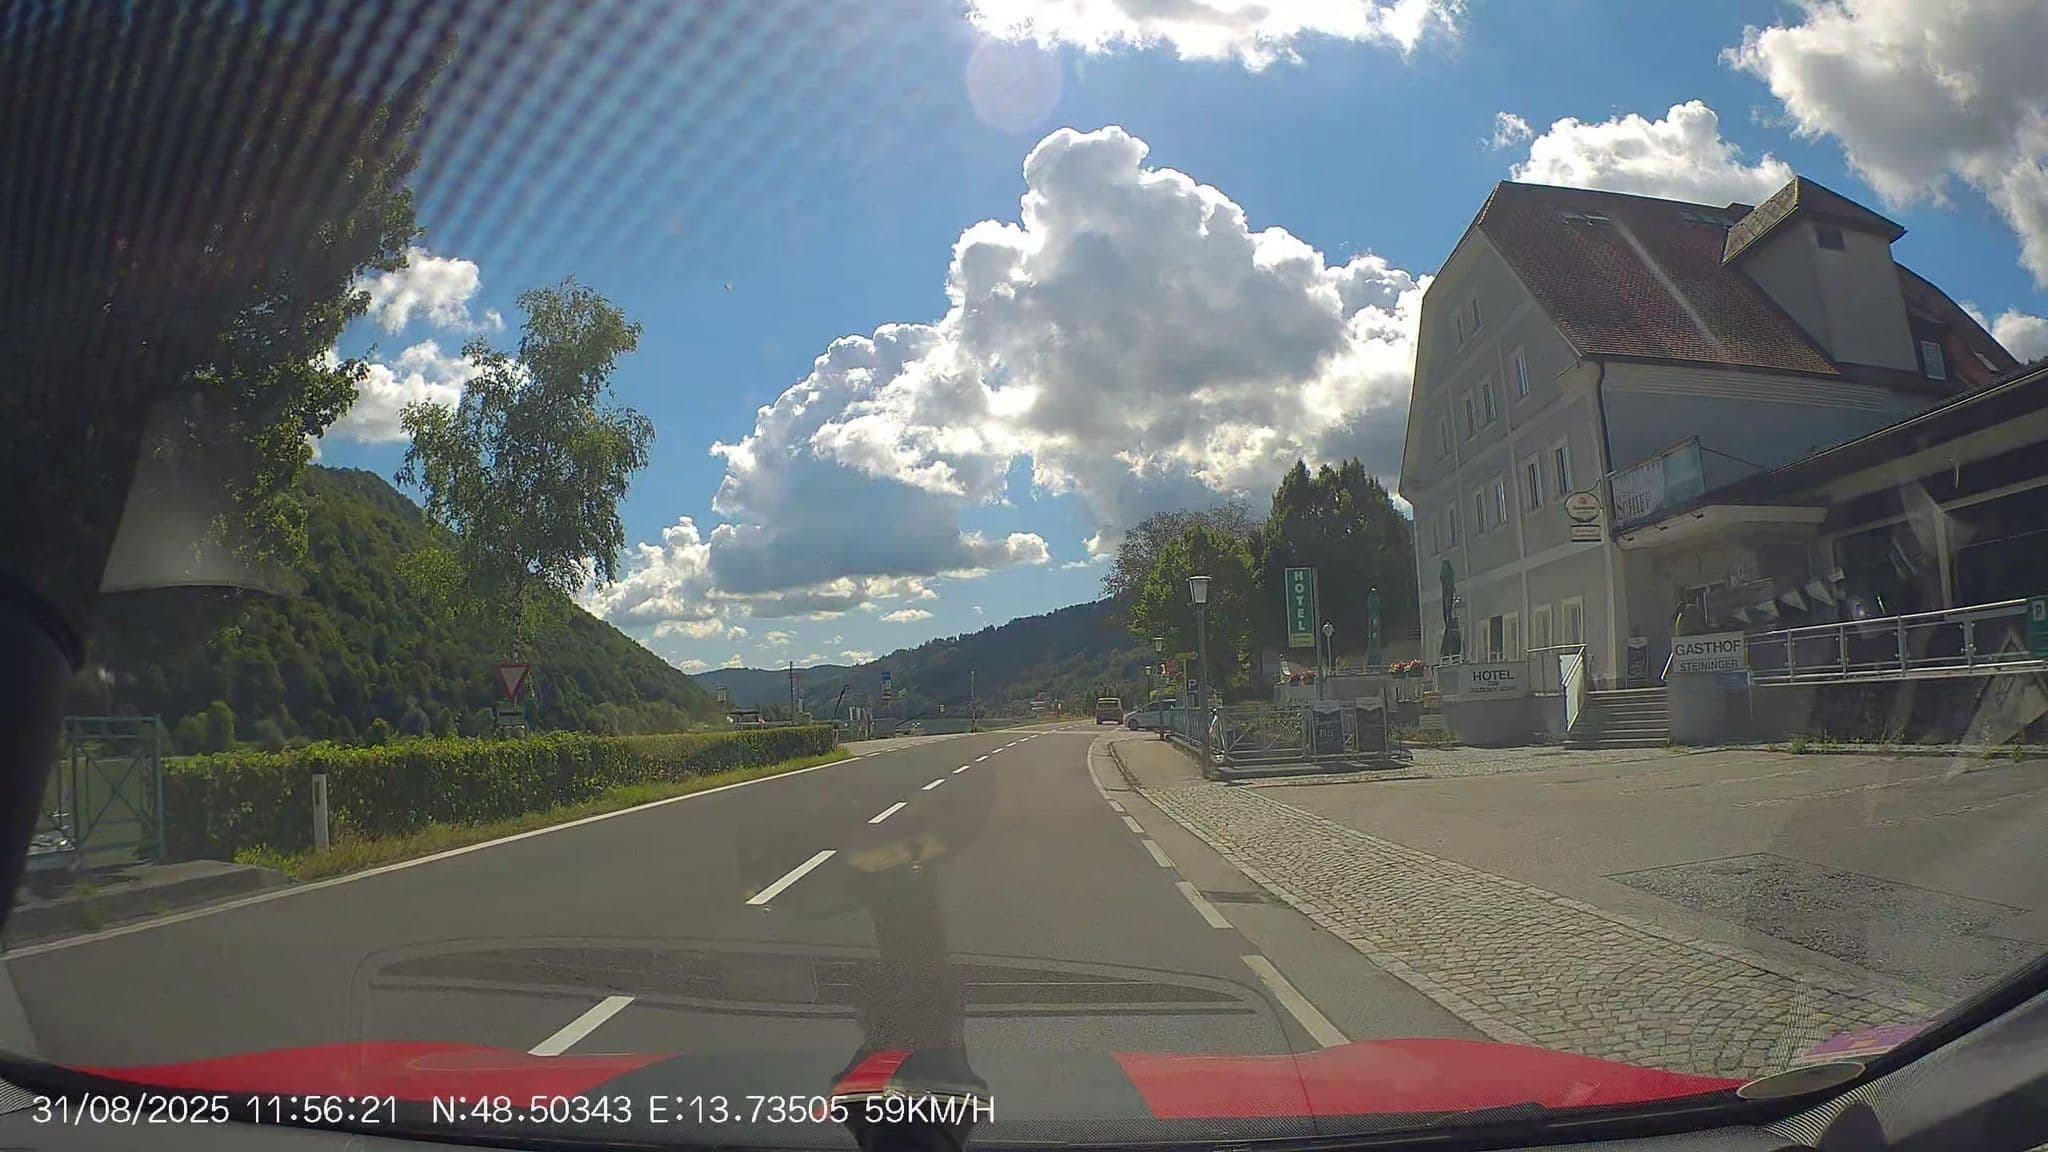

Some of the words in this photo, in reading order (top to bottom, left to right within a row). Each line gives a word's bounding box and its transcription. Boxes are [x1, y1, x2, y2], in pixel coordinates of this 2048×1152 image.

[1294, 571, 1305, 631] HOTEL
[1674, 639, 1741, 656] GASTHOF
[1680, 659, 1738, 672] STEININGER
[1472, 670, 1515, 681] HOTEL
[1188, 679, 1197, 690] P
